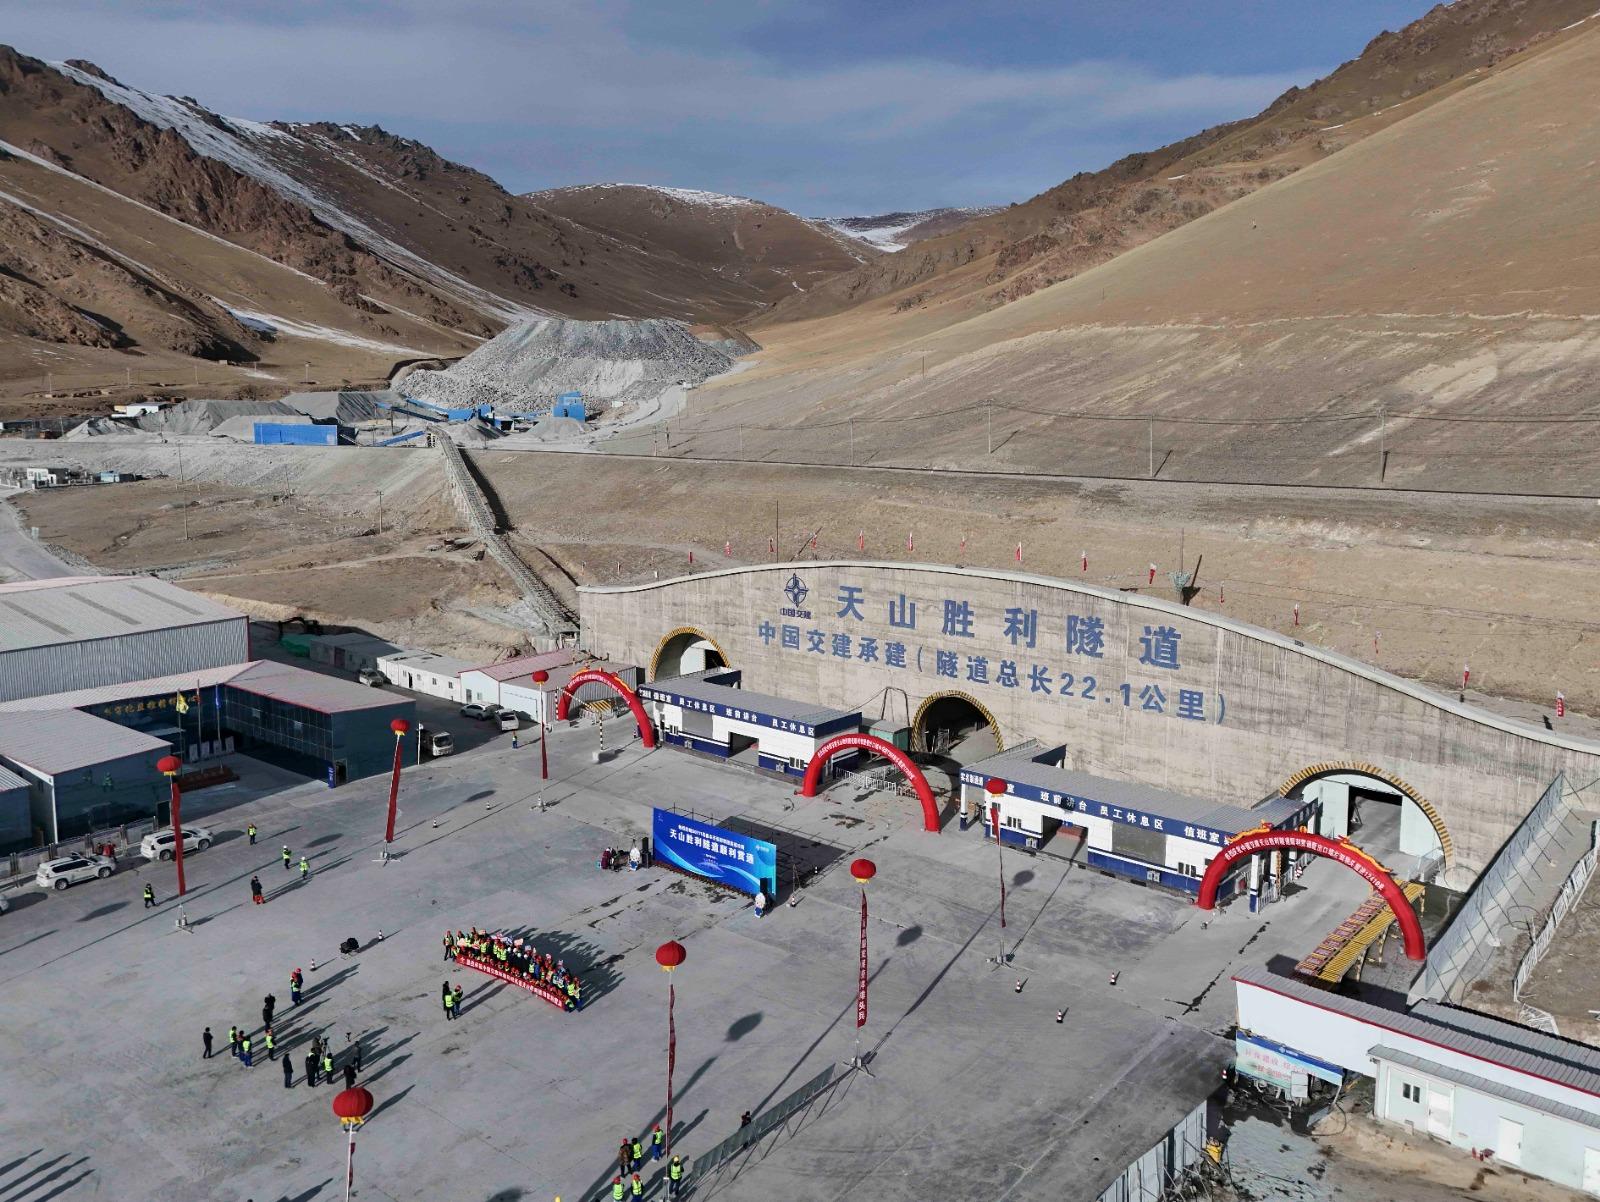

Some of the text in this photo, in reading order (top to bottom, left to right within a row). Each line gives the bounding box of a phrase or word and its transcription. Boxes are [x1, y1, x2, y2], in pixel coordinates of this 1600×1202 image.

[837, 585, 1181, 671] 天山胜利隧道
[679, 697, 716, 713] 员工休息区
[772, 718, 815, 736] 员工休息区
[1100, 805, 1163, 830] 员工休息区
[1184, 825, 1220, 844] 值班室
